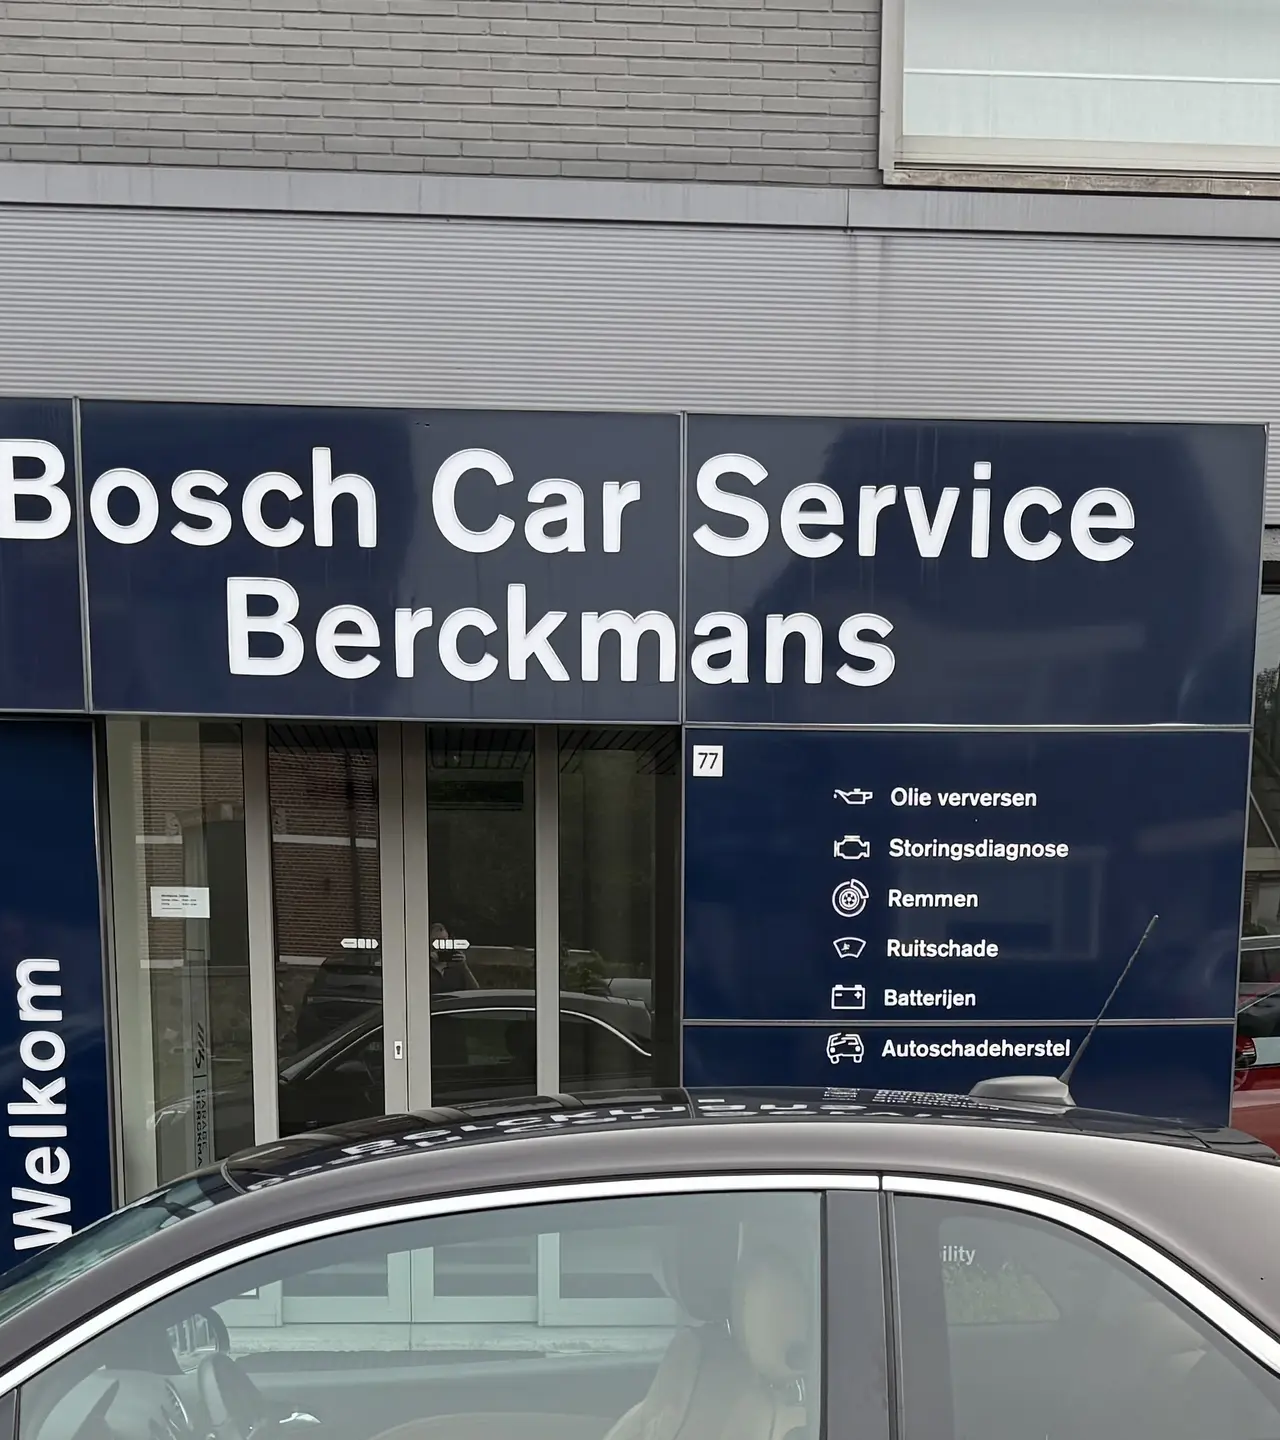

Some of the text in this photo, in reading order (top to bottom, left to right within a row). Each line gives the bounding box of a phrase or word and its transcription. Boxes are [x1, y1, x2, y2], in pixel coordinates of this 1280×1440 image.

[431, 447, 641, 555] Car
[693, 453, 1136, 562] Service
[227, 576, 896, 686] Berckmans
[698, 752, 718, 769] 77
[890, 787, 1037, 807] Olie verversen
[888, 838, 1069, 861] Storingsdiagnose
[888, 888, 978, 908] Remmen
[887, 938, 999, 958] Ruitschade
[884, 988, 976, 1010] Batterijen
[881, 1038, 1071, 1058] Autoschadeherstel
[7, 958, 72, 1250] Welkom
[941, 1245, 977, 1266] ility
